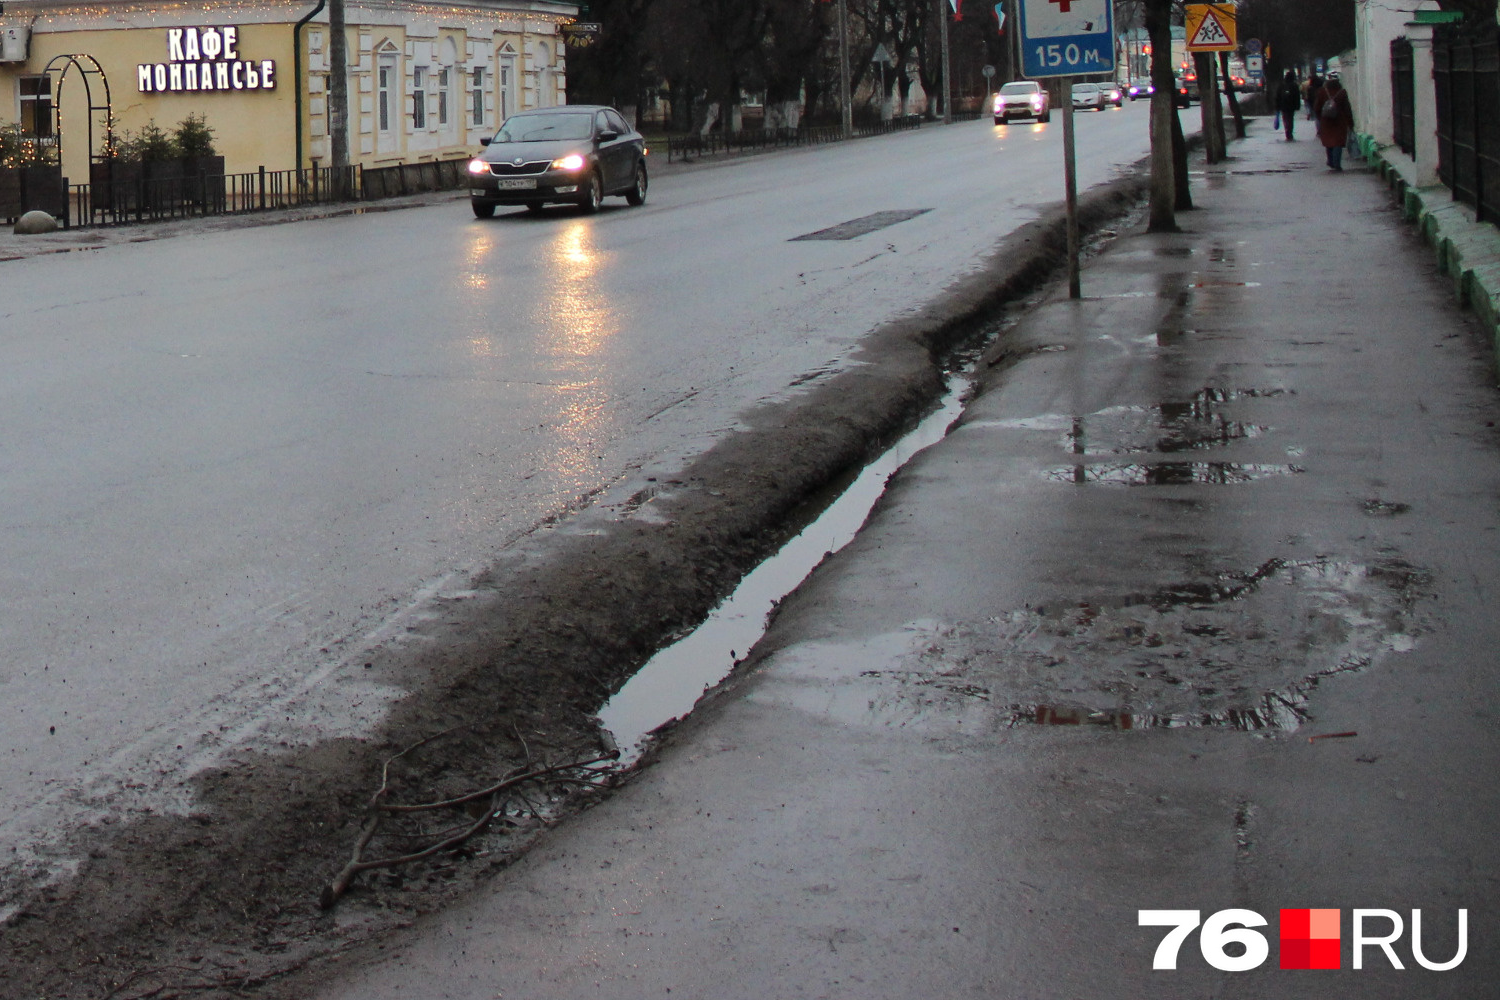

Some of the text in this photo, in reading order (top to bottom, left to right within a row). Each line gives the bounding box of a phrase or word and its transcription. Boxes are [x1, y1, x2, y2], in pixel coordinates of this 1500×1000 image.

[169, 26, 237, 61] КАФЕ
[1035, 43, 1080, 67] 150
[137, 60, 275, 92] МОНПАНСЬЕ
